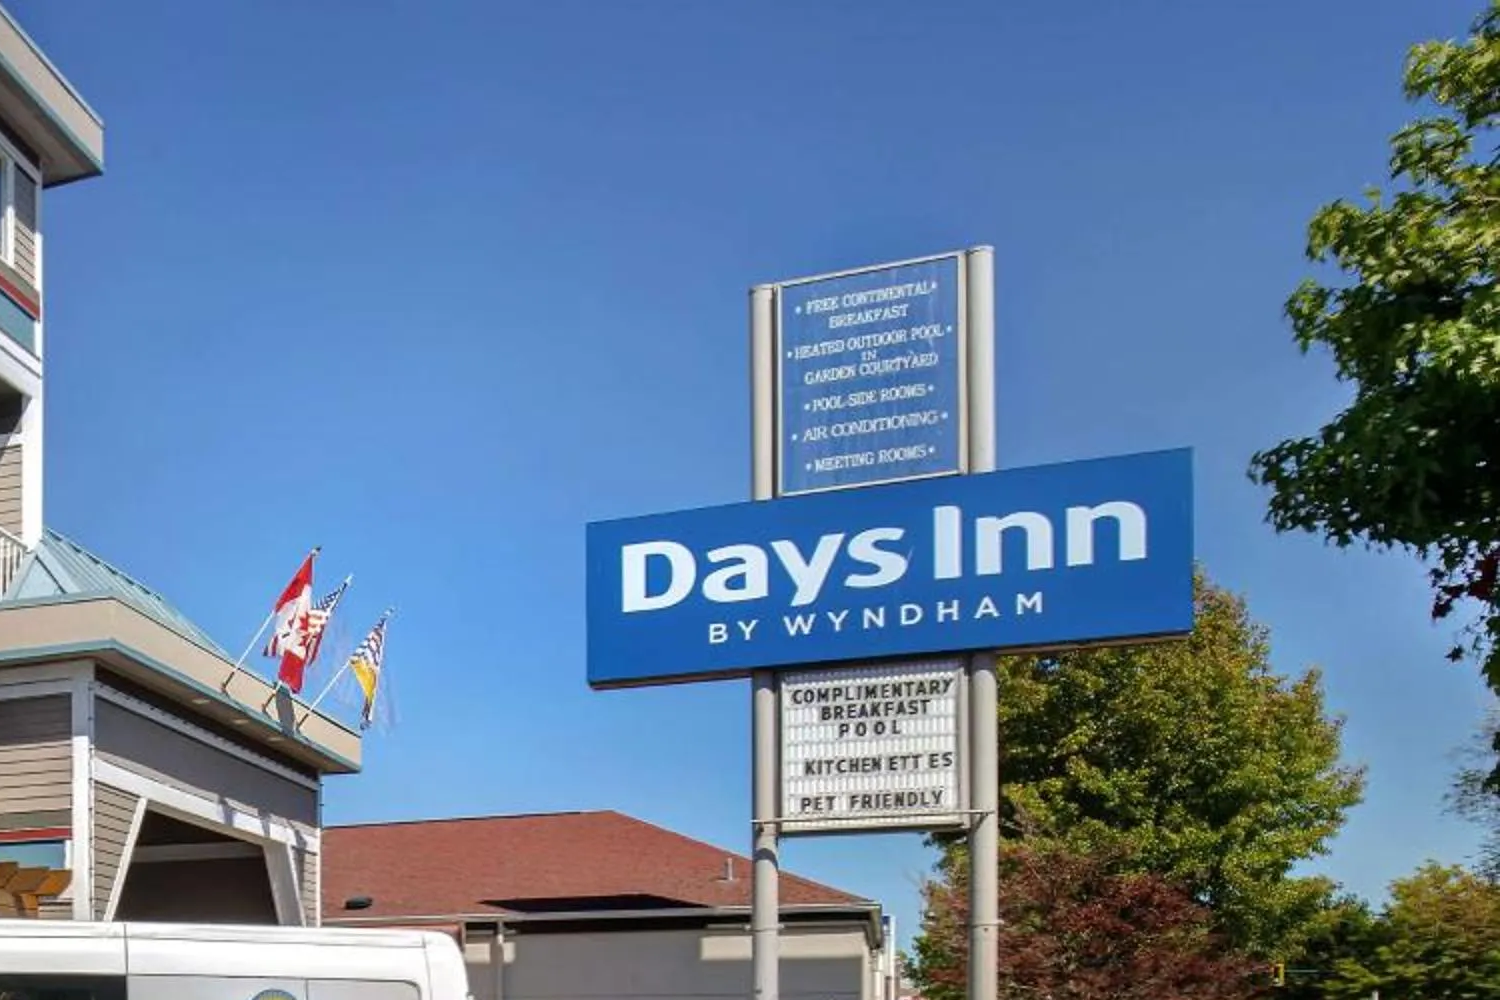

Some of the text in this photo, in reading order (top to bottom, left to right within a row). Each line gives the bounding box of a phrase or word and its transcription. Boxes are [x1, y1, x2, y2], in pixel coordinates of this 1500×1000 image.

[806, 282, 929, 314] FREE CONTINENTAL
[828, 305, 909, 328] BREAKFAST
[794, 324, 945, 360] HEATED OUTDOOR POOL
[804, 353, 940, 385] GARDEN COURTYARD
[861, 351, 877, 361] IN
[880, 384, 927, 401] ROOMS
[803, 410, 939, 442] AIR CONDITIONING
[814, 446, 928, 472] MEETING ROOMS
[621, 501, 1148, 614] Days Inn
[708, 591, 1044, 644] BY WYNDHAM
[791, 678, 953, 704] COMPLIMENTARY
[820, 699, 931, 721] BREAKFAST
[838, 721, 901, 737] POOL
[800, 789, 944, 811] PET FRIENDLY
